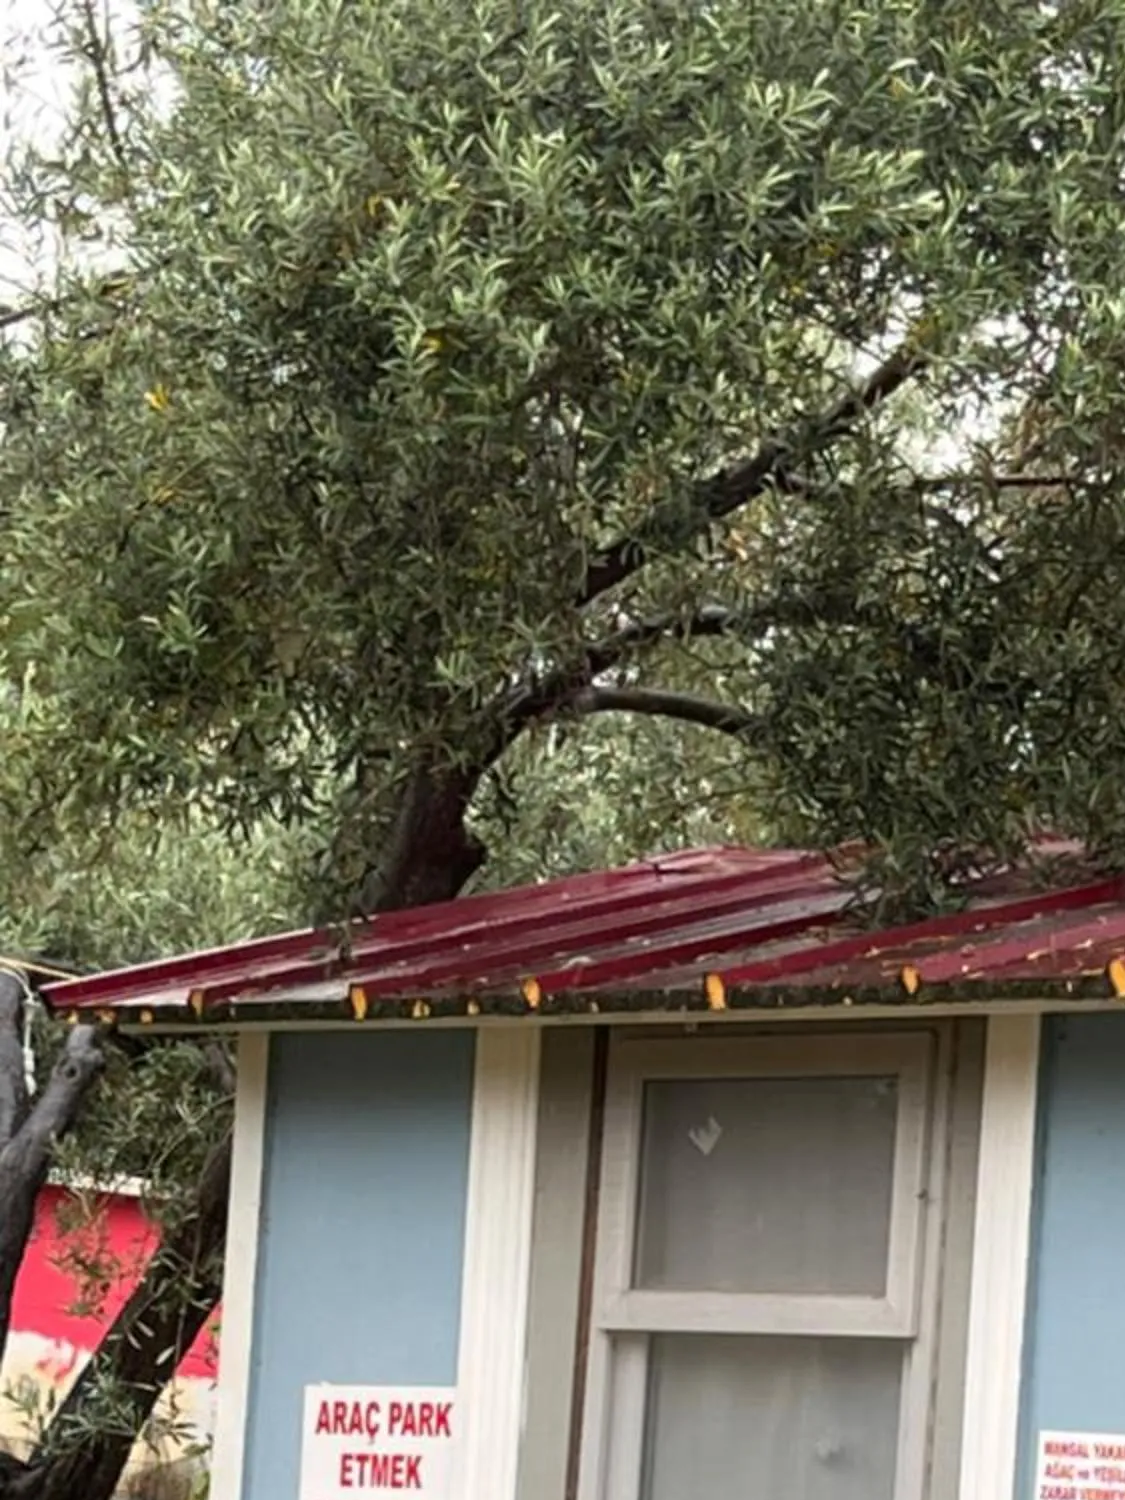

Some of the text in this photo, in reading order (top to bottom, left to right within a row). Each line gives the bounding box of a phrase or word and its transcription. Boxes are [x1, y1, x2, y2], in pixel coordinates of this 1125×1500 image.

[315, 1400, 453, 1445] ARAÇ PARK
[340, 1453, 423, 1489] ETMEK
[1040, 1484, 1077, 1500] ZARAR
